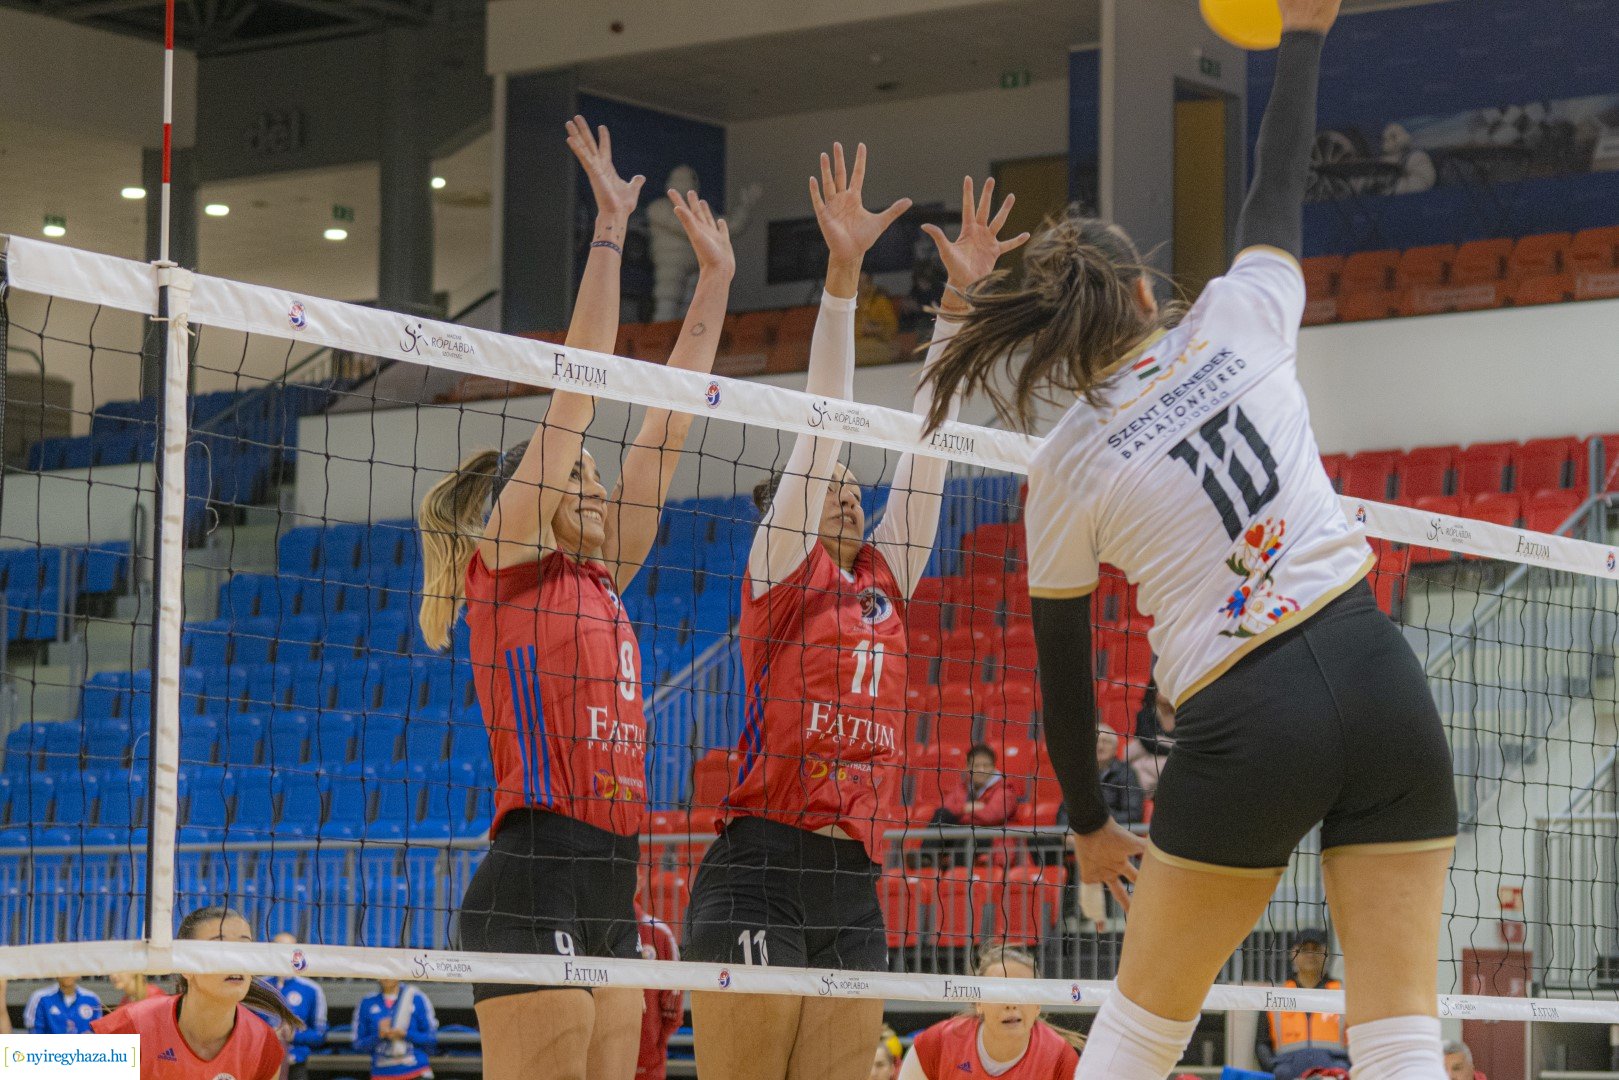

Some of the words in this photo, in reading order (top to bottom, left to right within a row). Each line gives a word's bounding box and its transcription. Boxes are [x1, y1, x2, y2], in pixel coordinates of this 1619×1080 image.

[431, 337, 475, 354] RÖPLABDA
[553, 352, 607, 385] FATUM
[1108, 405, 1161, 448] SZENT
[1160, 347, 1233, 407] BENEDEK
[1121, 358, 1247, 459] BALATONFÜRED
[1167, 404, 1280, 542] 10
[620, 640, 636, 701] 9
[851, 639, 885, 698] 11
[806, 700, 896, 750] FATUM
[563, 962, 609, 982] FATUM
[738, 930, 769, 966] 11
